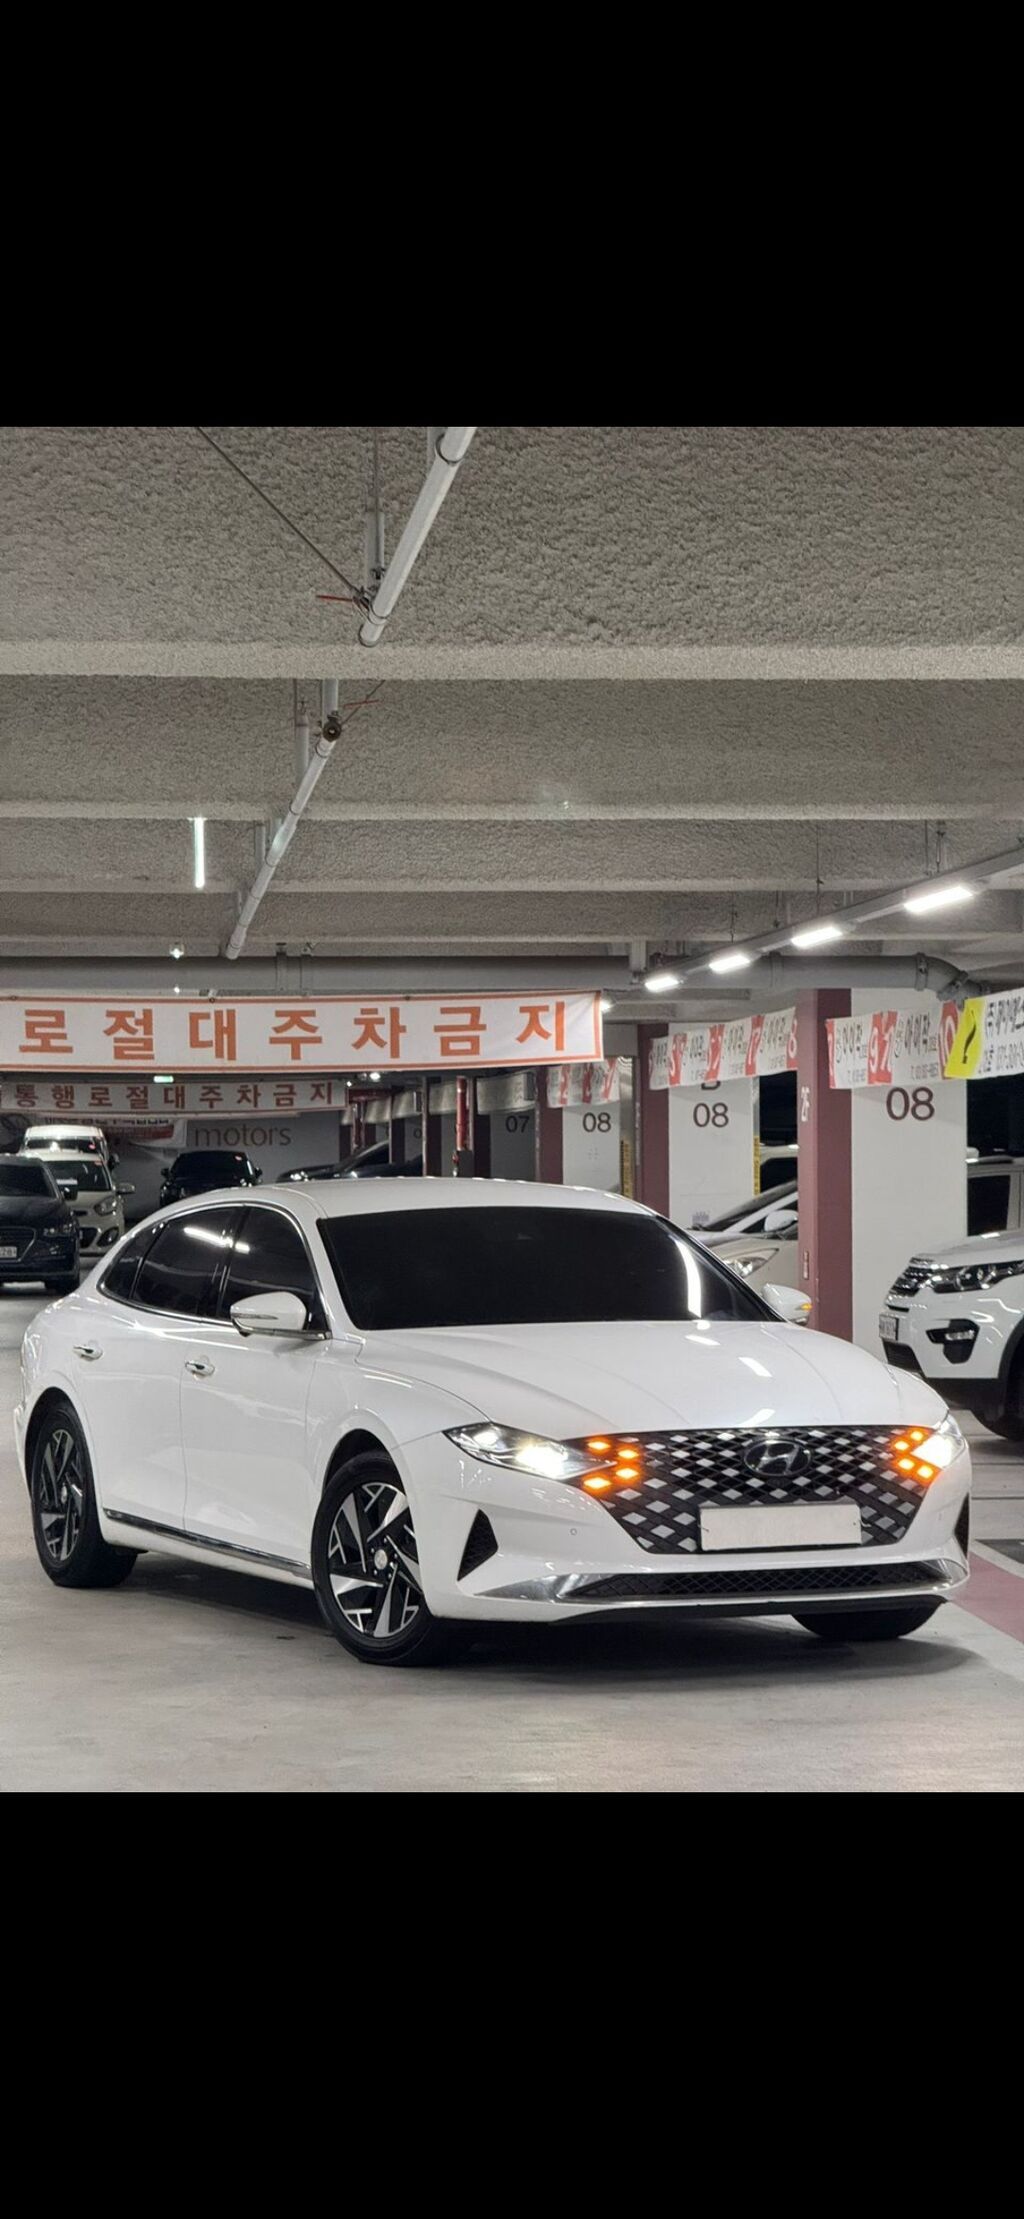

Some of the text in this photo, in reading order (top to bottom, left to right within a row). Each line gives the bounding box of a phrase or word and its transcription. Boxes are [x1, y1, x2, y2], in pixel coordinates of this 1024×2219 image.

[693, 1102, 729, 1128] 08
[886, 1086, 935, 1121] 08
[505, 1115, 530, 1133] 07
[583, 1112, 612, 1133] 08
[194, 1123, 292, 1147] motors
